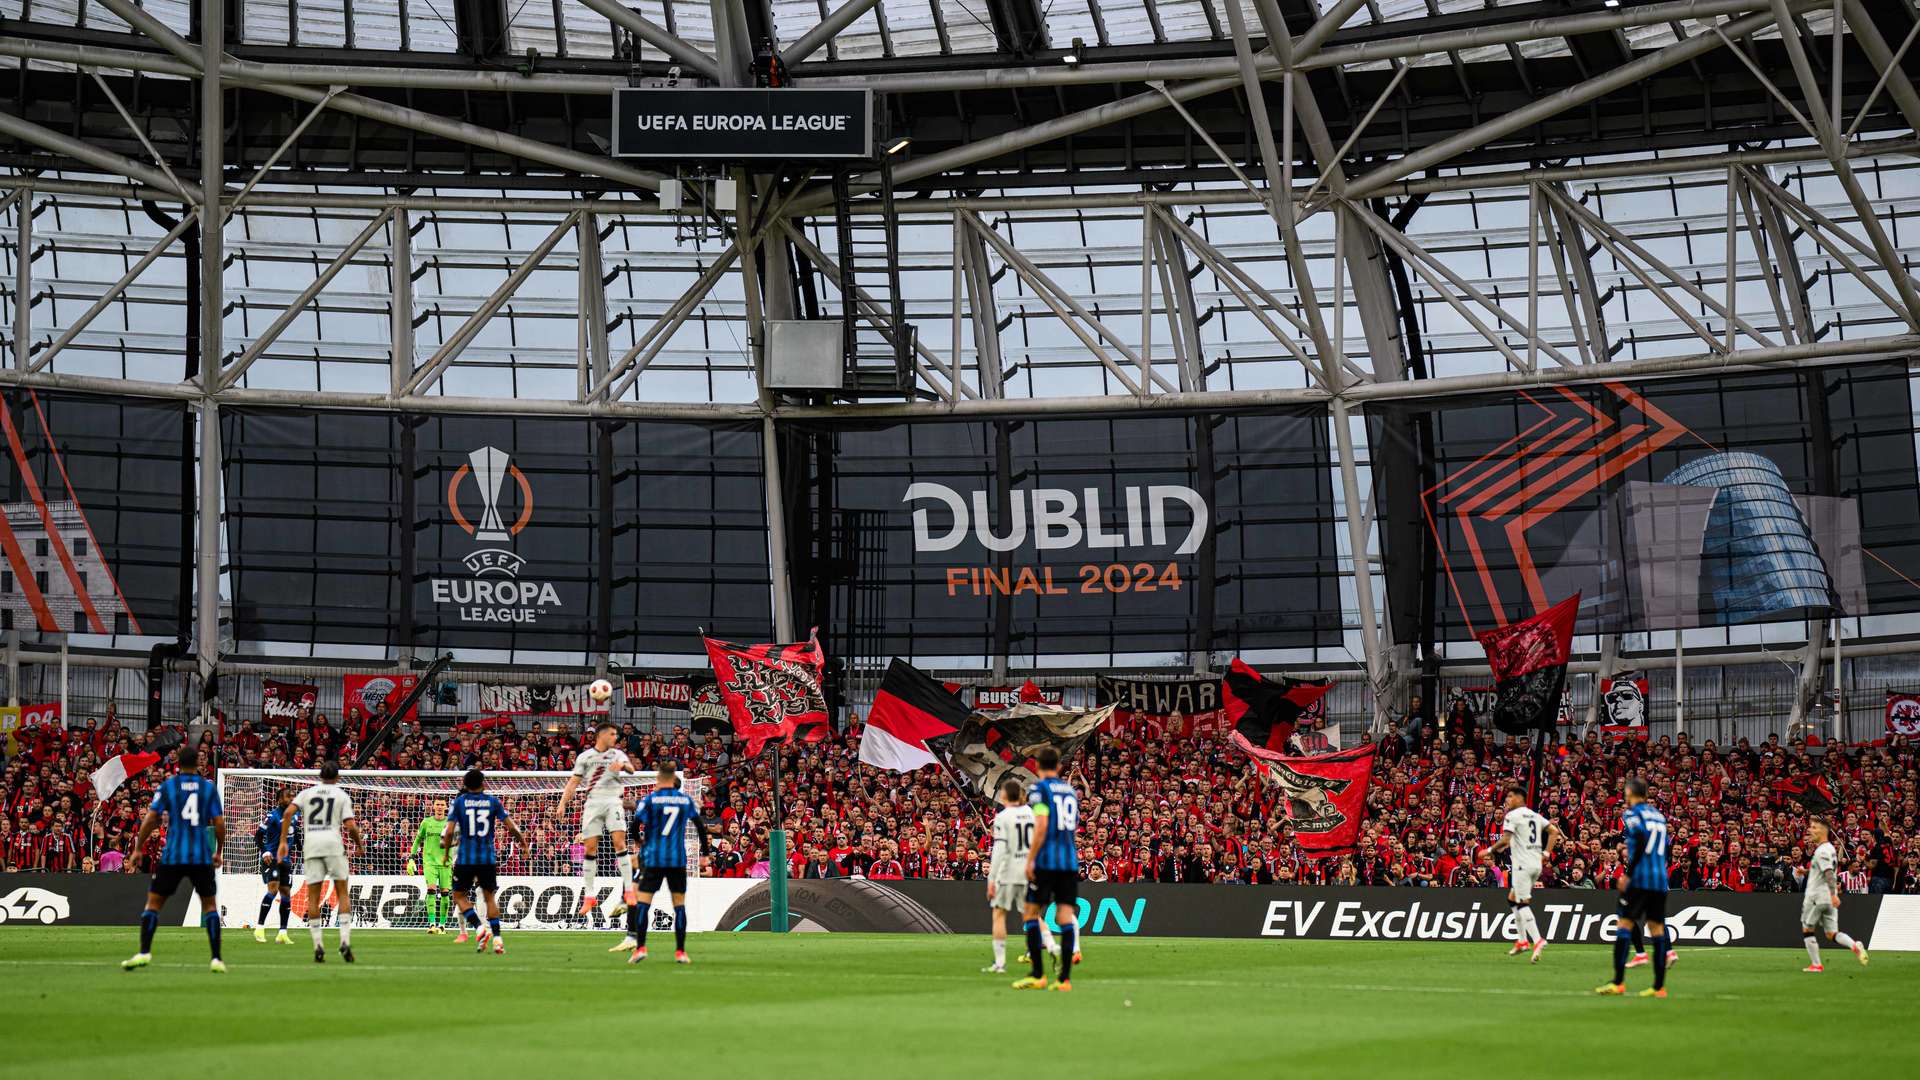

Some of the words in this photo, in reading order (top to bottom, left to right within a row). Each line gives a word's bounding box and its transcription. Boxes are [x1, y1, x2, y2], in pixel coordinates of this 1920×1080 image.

[638, 115, 688, 131] UEFA
[693, 115, 767, 131] EUROPA
[902, 482, 1209, 555] DUBLIN
[466, 553, 520, 574] UEFA
[431, 579, 562, 606] EUROPA
[946, 567, 1068, 596] FINAL
[1079, 562, 1182, 594] 2024
[625, 681, 689, 701] DJANGOS
[181, 793, 200, 827] 4
[308, 797, 335, 825] 21
[465, 808, 490, 837] 13
[661, 806, 680, 836] 7
[1053, 795, 1078, 831] 19
[1528, 820, 1537, 844] 3
[1645, 821, 1667, 856] 77
[1261, 900, 1325, 936] EV
[1330, 901, 1519, 940] Exclusive
[1544, 903, 1620, 941] Tire
